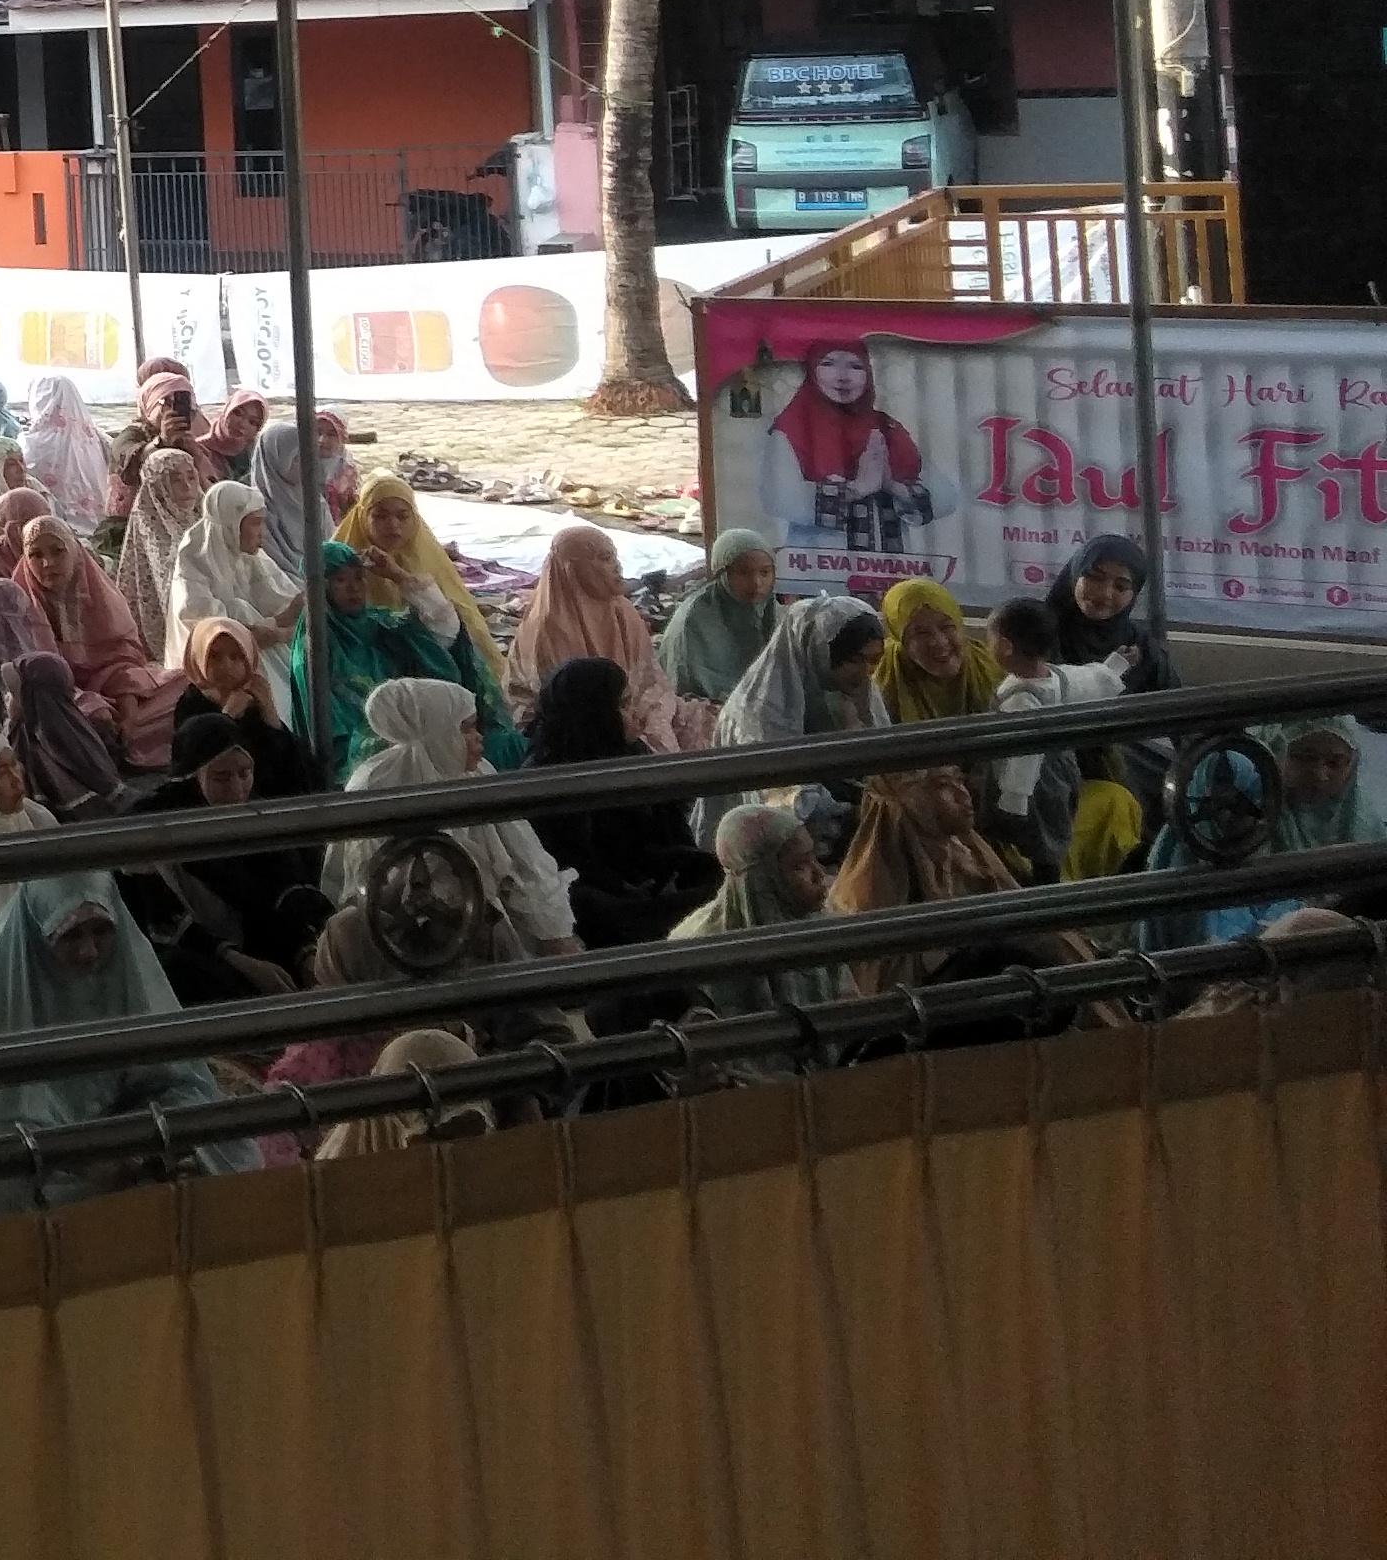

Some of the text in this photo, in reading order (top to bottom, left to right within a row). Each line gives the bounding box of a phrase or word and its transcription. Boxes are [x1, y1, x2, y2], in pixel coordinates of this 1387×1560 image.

[768, 63, 885, 83] BBC HOTEL
[1047, 367, 1202, 406] Selaat
[1222, 374, 1313, 408] Hari
[975, 414, 1179, 513] Idul
[1002, 525, 1060, 545] Minal
[1174, 535, 1232, 555] faizin
[1239, 540, 1316, 561] Mohon
[1322, 545, 1380, 565] Maaf
[817, 554, 853, 572] EVA
[856, 556, 934, 577] DWIANA
